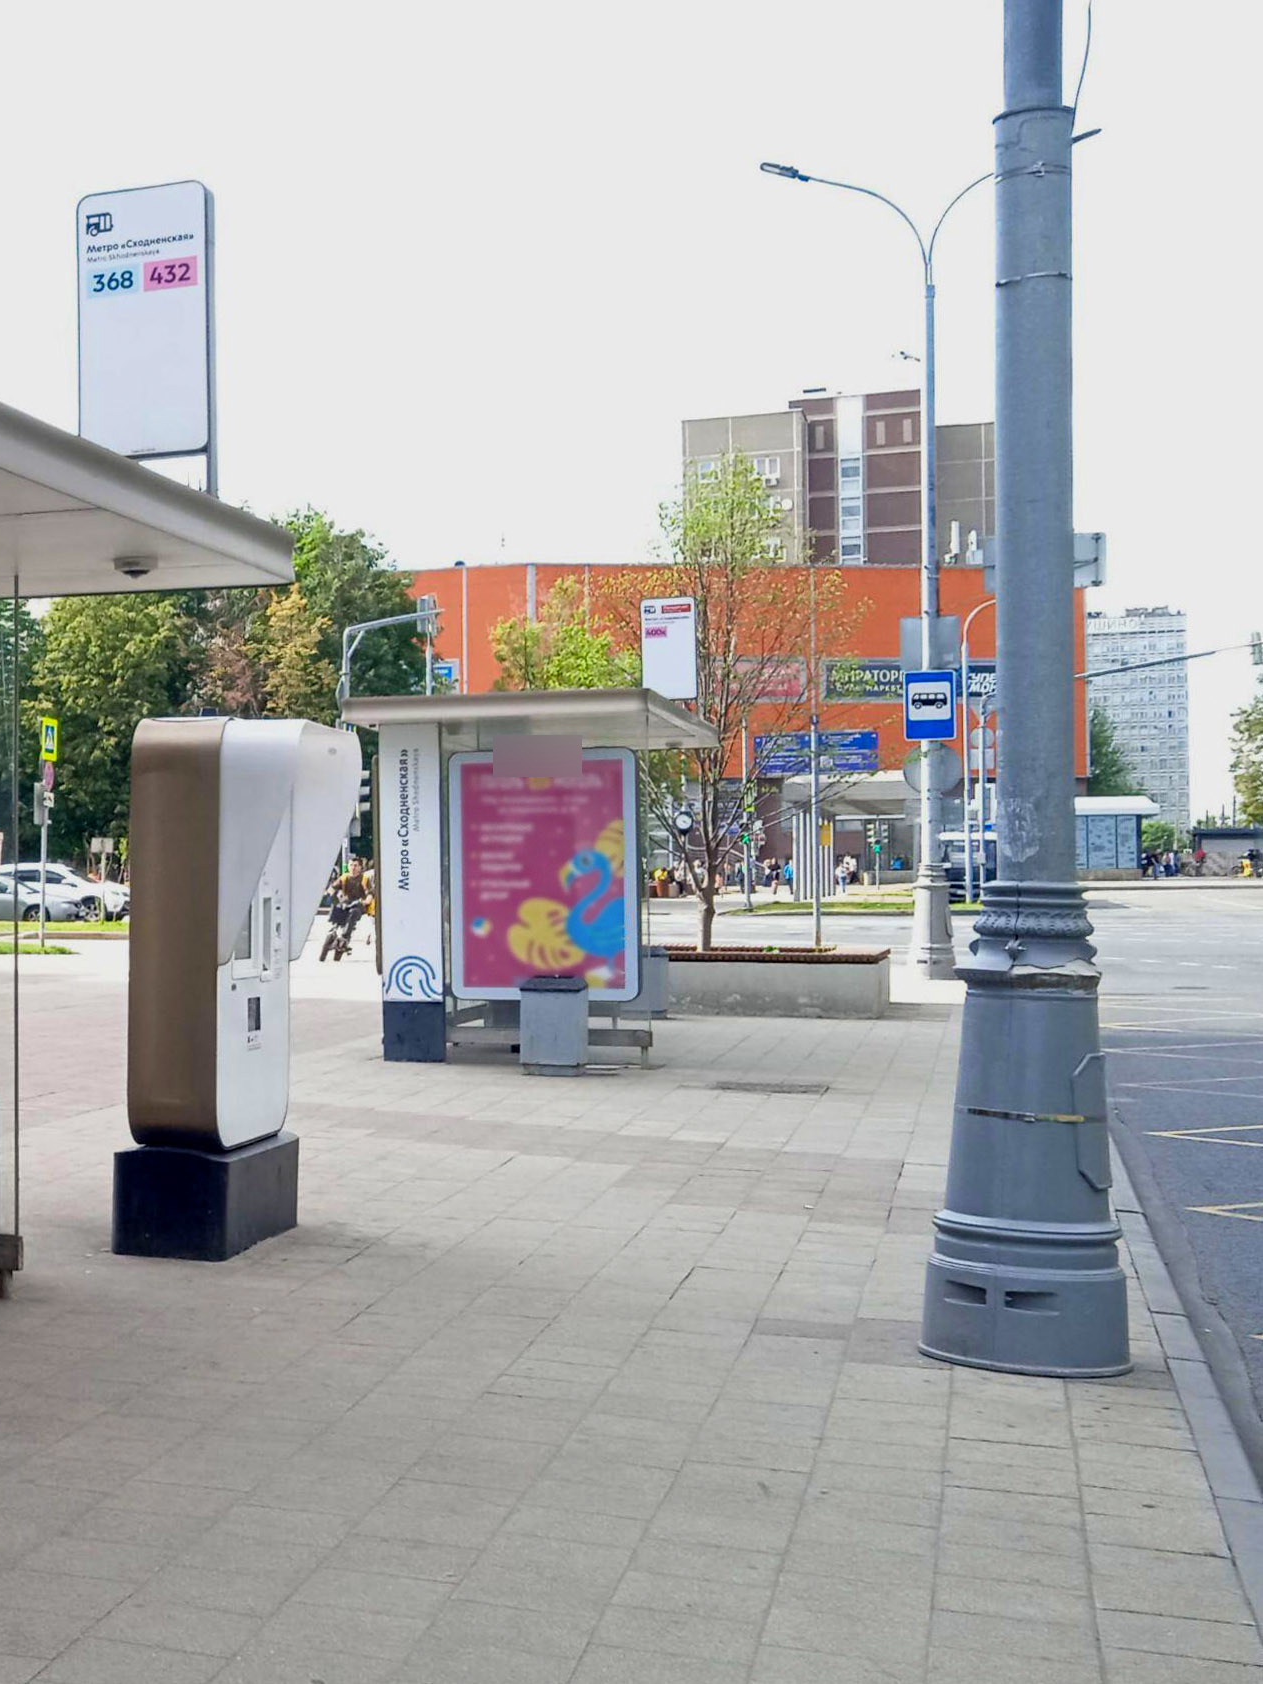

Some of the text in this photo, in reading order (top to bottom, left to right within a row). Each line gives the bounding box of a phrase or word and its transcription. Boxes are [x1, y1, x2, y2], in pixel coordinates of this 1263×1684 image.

[86, 233, 194, 254] Метро «Сходненская»
[92, 263, 191, 293] 368 432
[397, 748, 412, 891] Метро «Сходненская»
